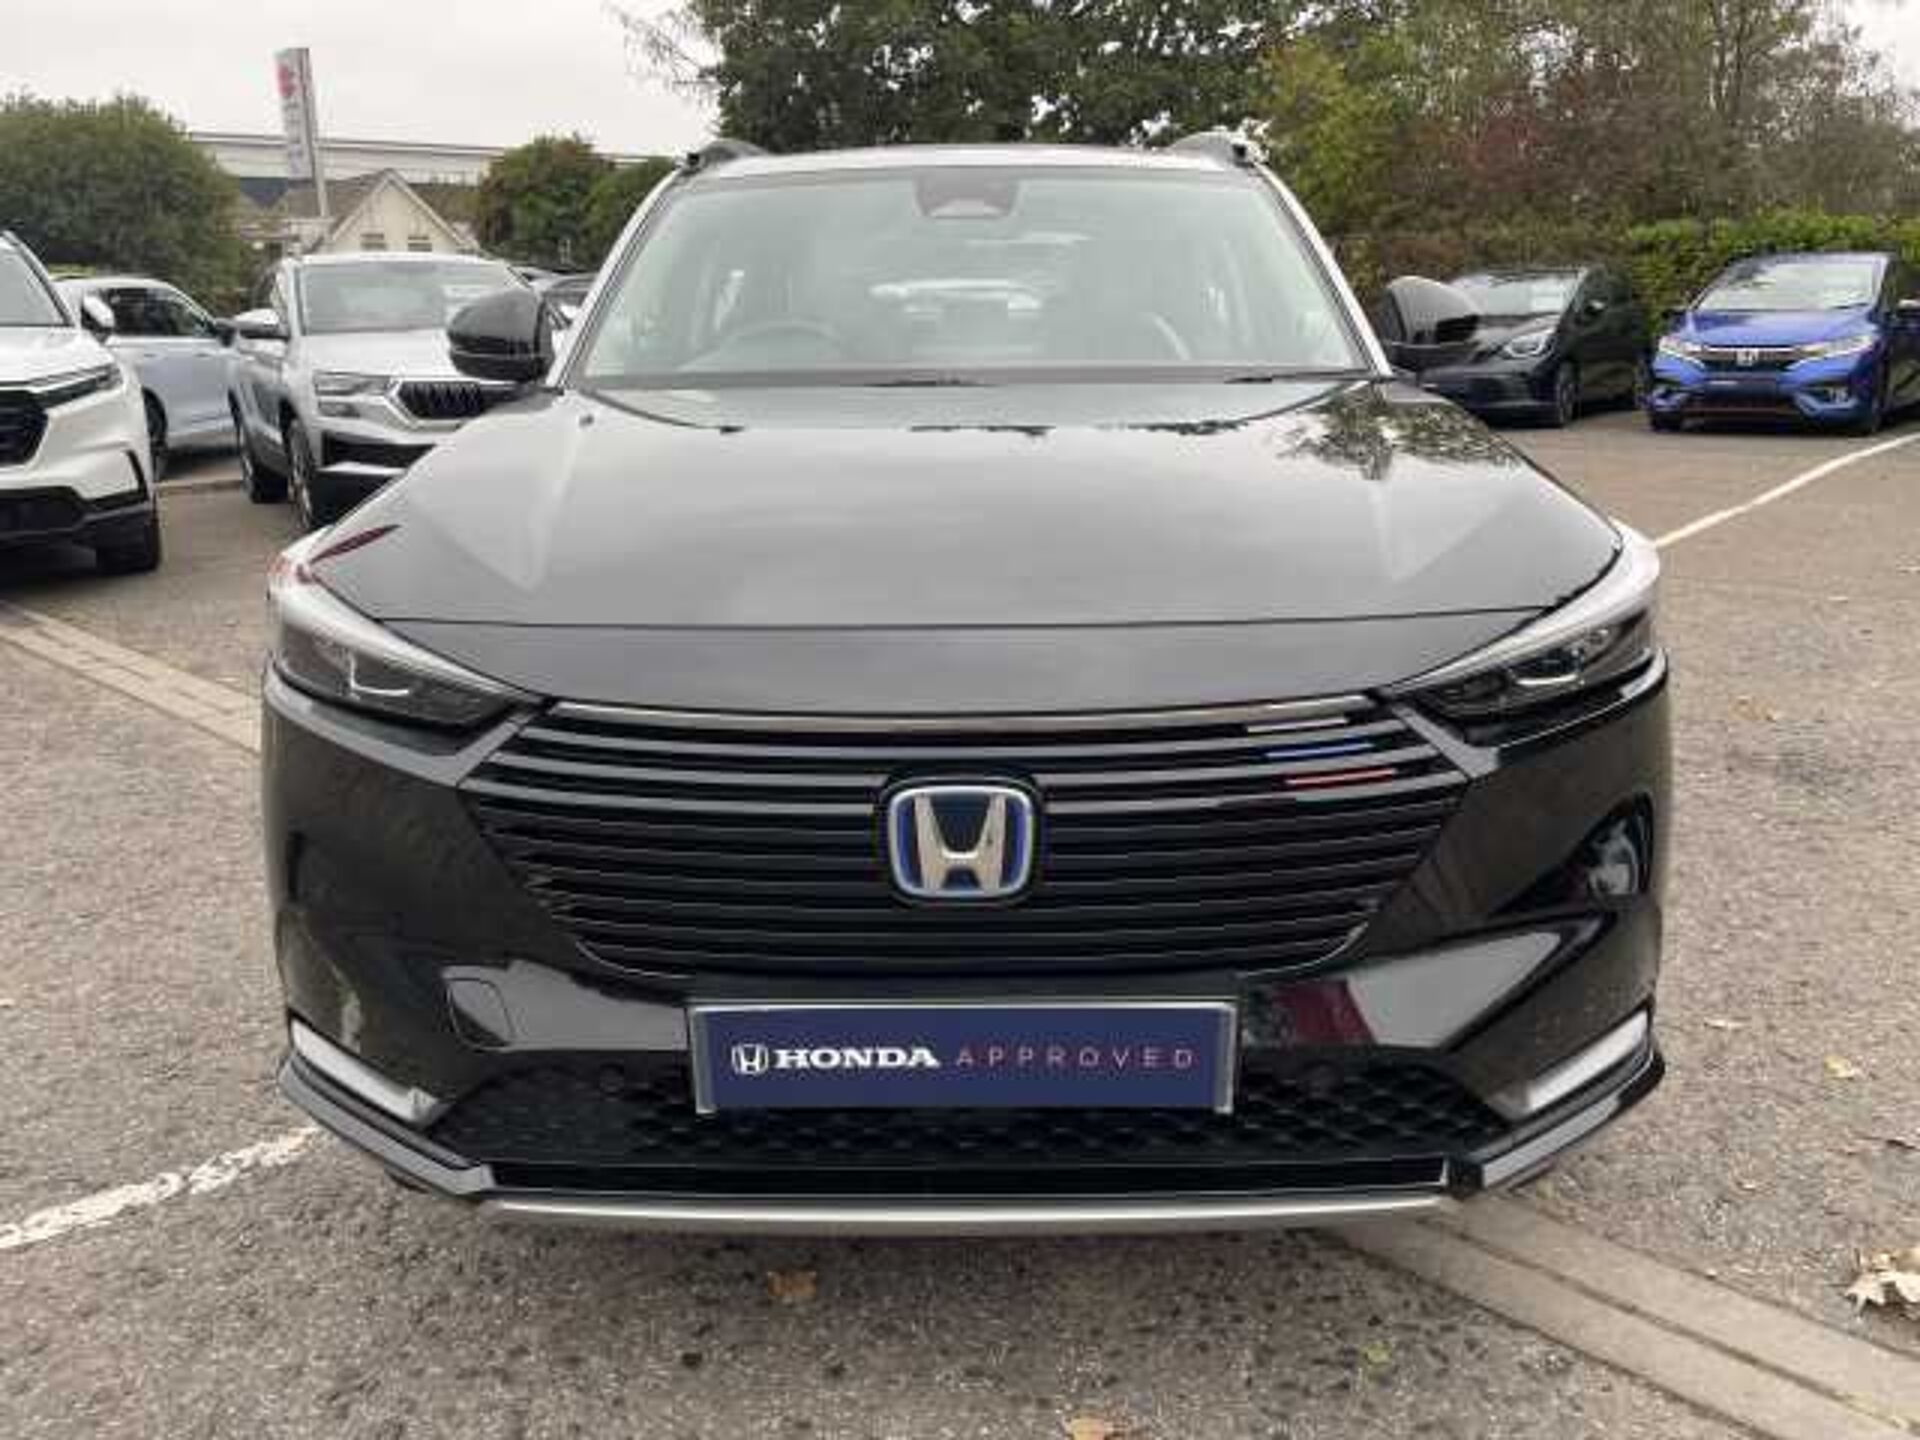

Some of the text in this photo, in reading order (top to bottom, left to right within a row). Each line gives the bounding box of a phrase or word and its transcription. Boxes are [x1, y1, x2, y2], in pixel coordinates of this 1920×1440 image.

[911, 790, 1009, 891] H
[776, 1046, 939, 1070] HONDA
[956, 1045, 1194, 1068] APPROVED
